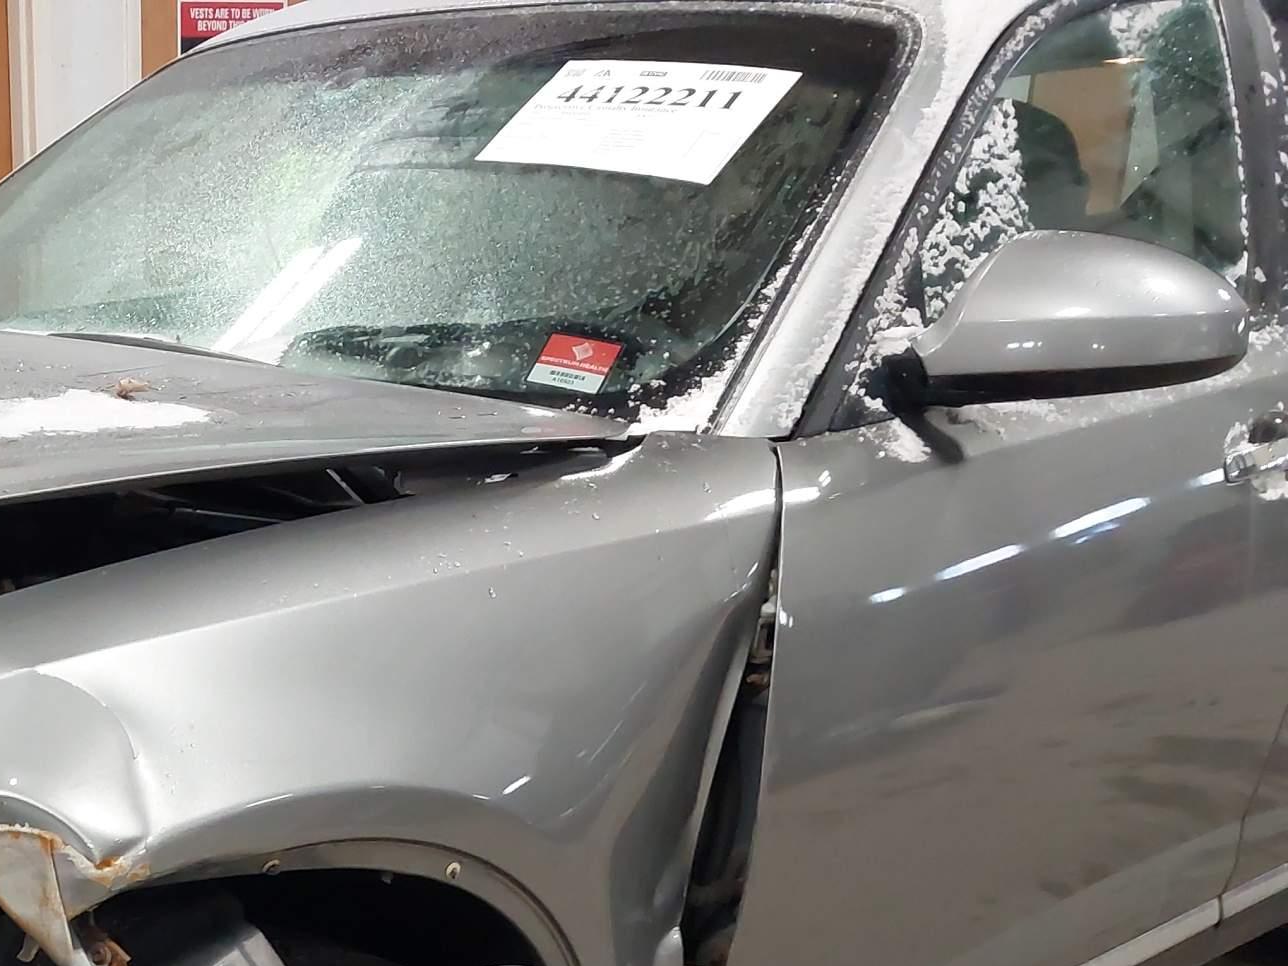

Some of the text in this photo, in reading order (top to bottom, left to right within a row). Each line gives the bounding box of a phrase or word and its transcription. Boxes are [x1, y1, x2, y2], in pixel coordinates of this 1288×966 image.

[190, 8, 214, 19] VESTS
[214, 8, 230, 19] ARE
[231, 8, 241, 19] TO
[241, 8, 252, 19] BE
[197, 20, 228, 31] BEYOND
[557, 84, 743, 110] 44122211
